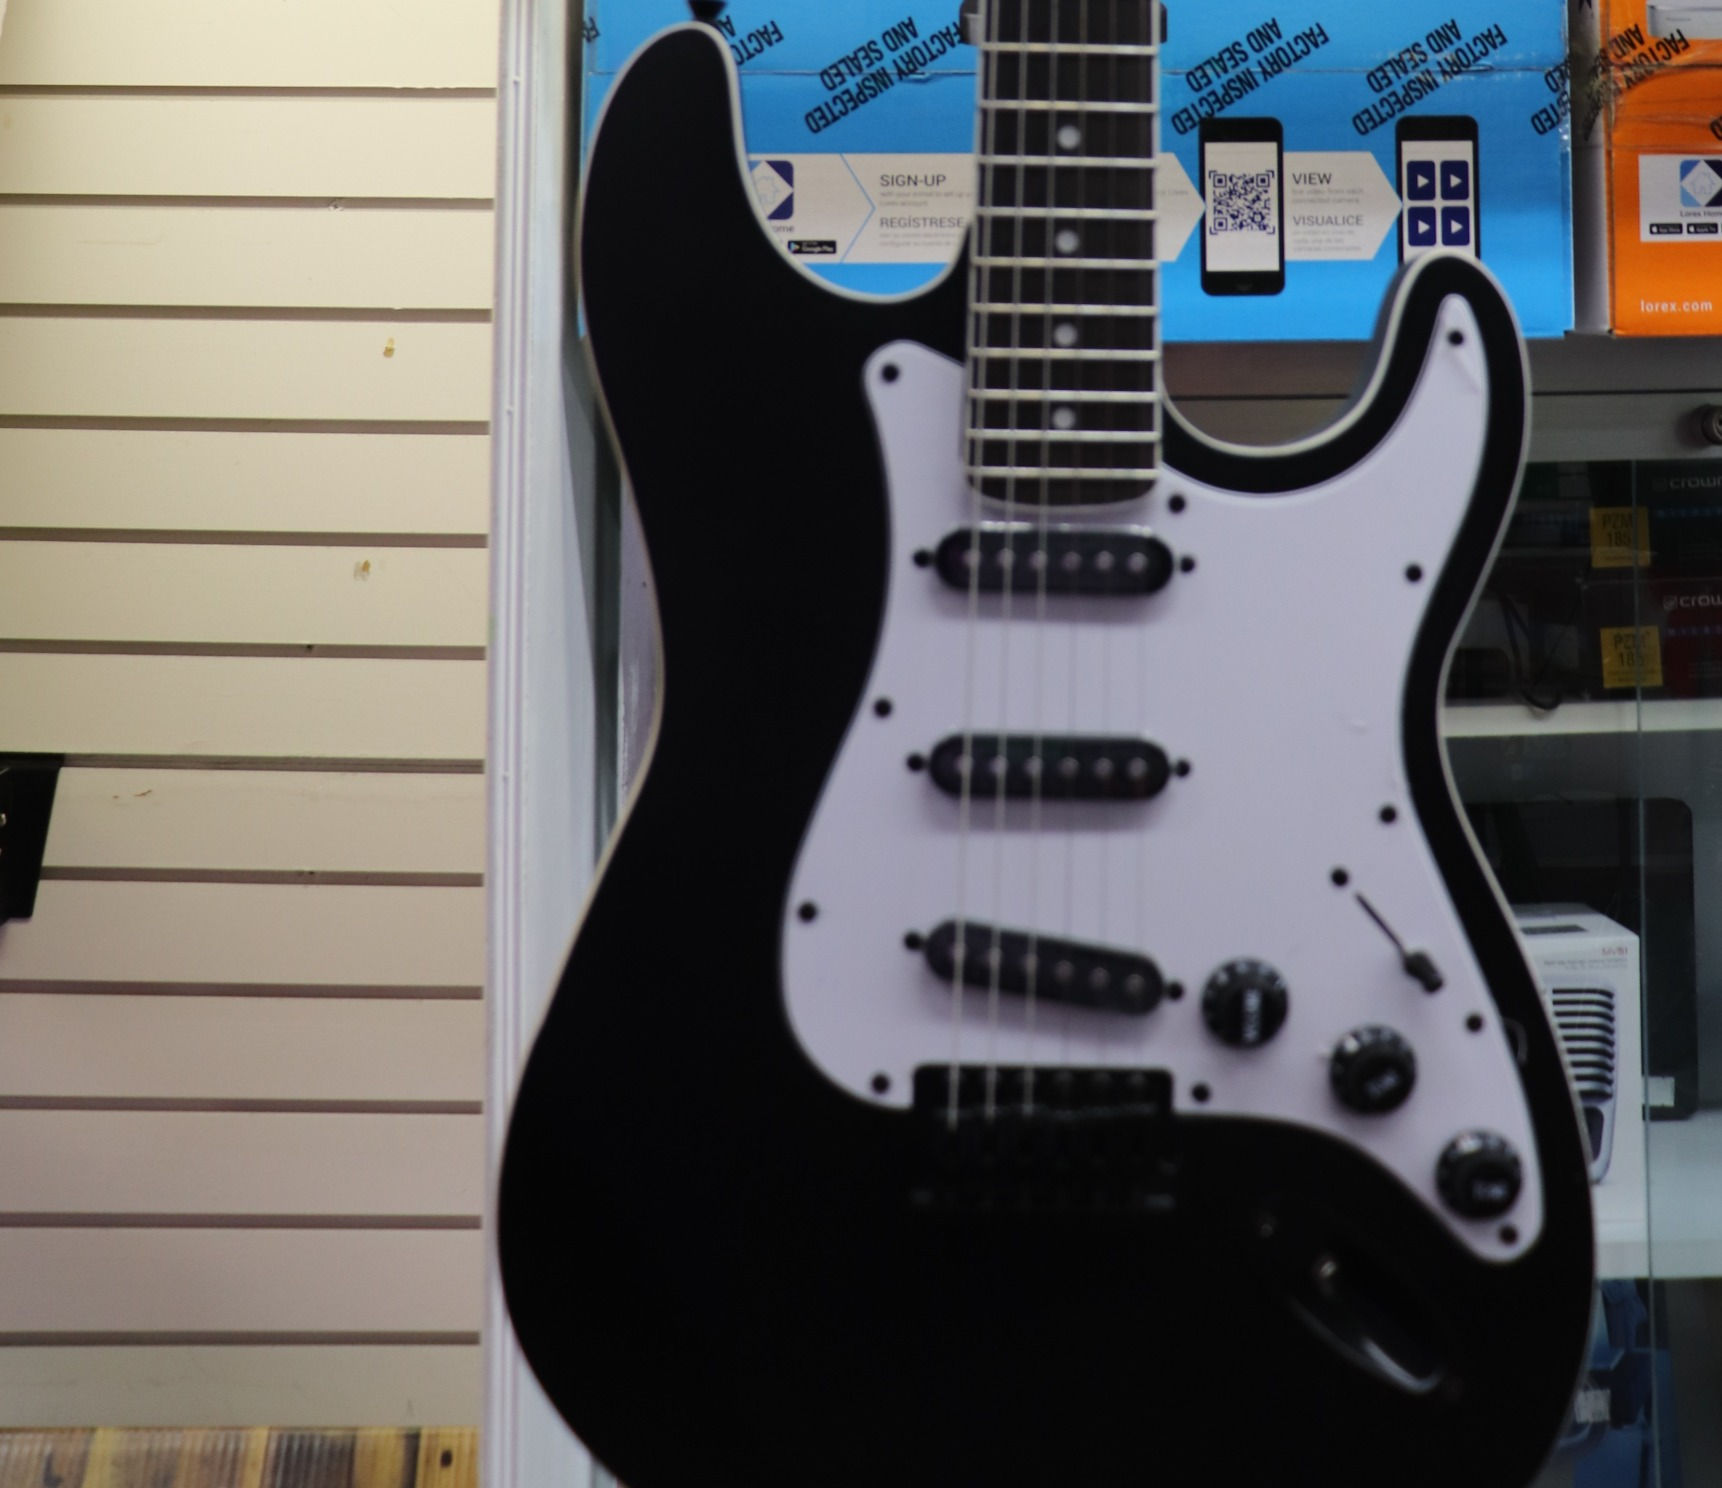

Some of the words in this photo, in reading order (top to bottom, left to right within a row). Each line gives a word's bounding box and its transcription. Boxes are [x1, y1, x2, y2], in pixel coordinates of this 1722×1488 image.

[882, 16, 919, 53] AND
[892, 20, 964, 82] FACTORY
[1246, 17, 1283, 54] AND
[1257, 22, 1330, 83] FACTORY
[1425, 18, 1462, 54] AND
[1437, 23, 1509, 84] FACTORY
[819, 39, 885, 92] SEALED
[1185, 40, 1249, 93] SEALED
[1366, 41, 1428, 94] SEALED
[804, 66, 895, 135] INSPECTED
[1170, 67, 1261, 136] INSPECTED
[1352, 67, 1441, 136] INSPECTED
[879, 173, 947, 187] SIGN-UP
[1292, 172, 1333, 185] VIEW
[774, 224, 795, 233] ome
[879, 214, 965, 229] REGÍSTRESE
[1292, 214, 1365, 227] VISUALICE
[1640, 299, 1713, 313] lorex.com
